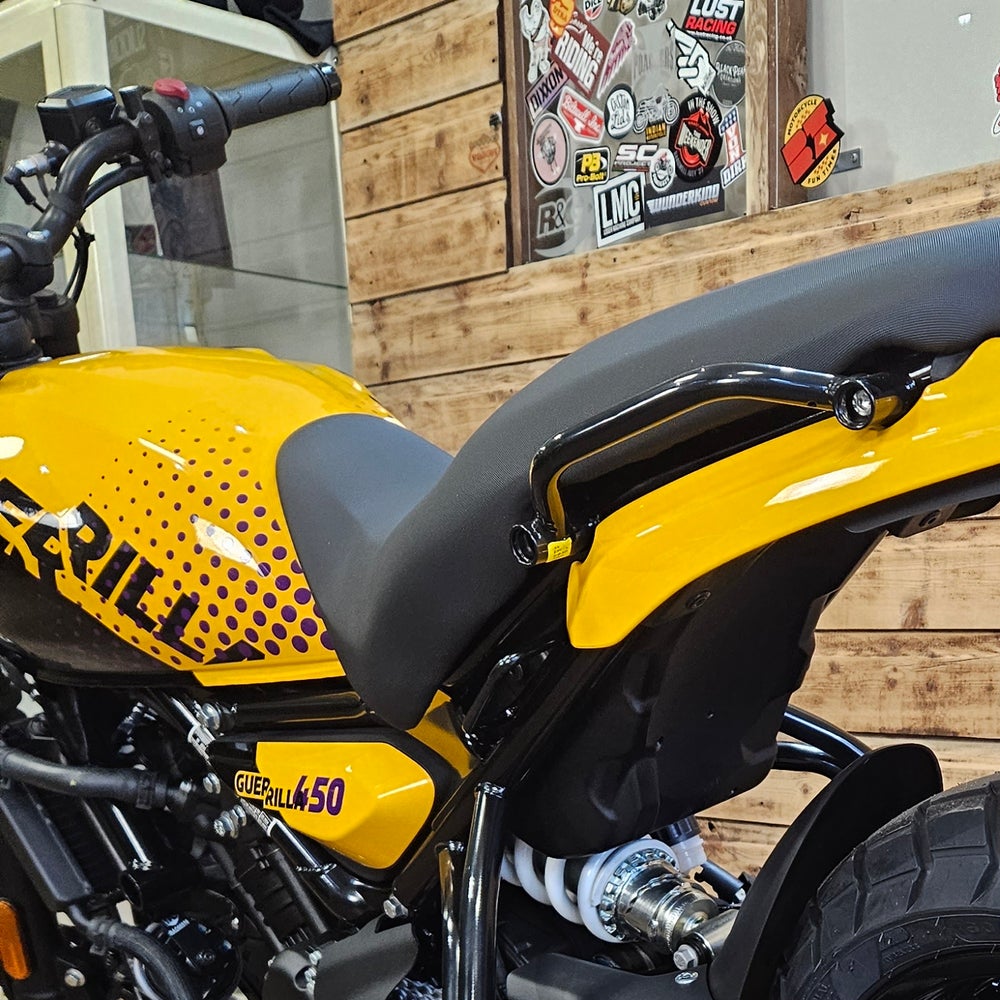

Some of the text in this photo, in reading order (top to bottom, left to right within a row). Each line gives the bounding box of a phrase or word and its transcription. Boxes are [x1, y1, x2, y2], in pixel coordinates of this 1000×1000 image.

[689, 0, 744, 20] LUST
[685, 15, 737, 35] RACING
[554, 30, 599, 90] RIDING
[529, 66, 564, 112] DIXXON
[695, 97, 706, 108] THE
[705, 101, 721, 125] SHOW
[787, 98, 817, 136] MOTORCYCLE
[581, 152, 601, 173] PB
[576, 172, 606, 183] Pro-Bolt
[807, 176, 821, 185] FUN
[600, 180, 641, 228] LMC
[292, 775, 345, 816] 450
